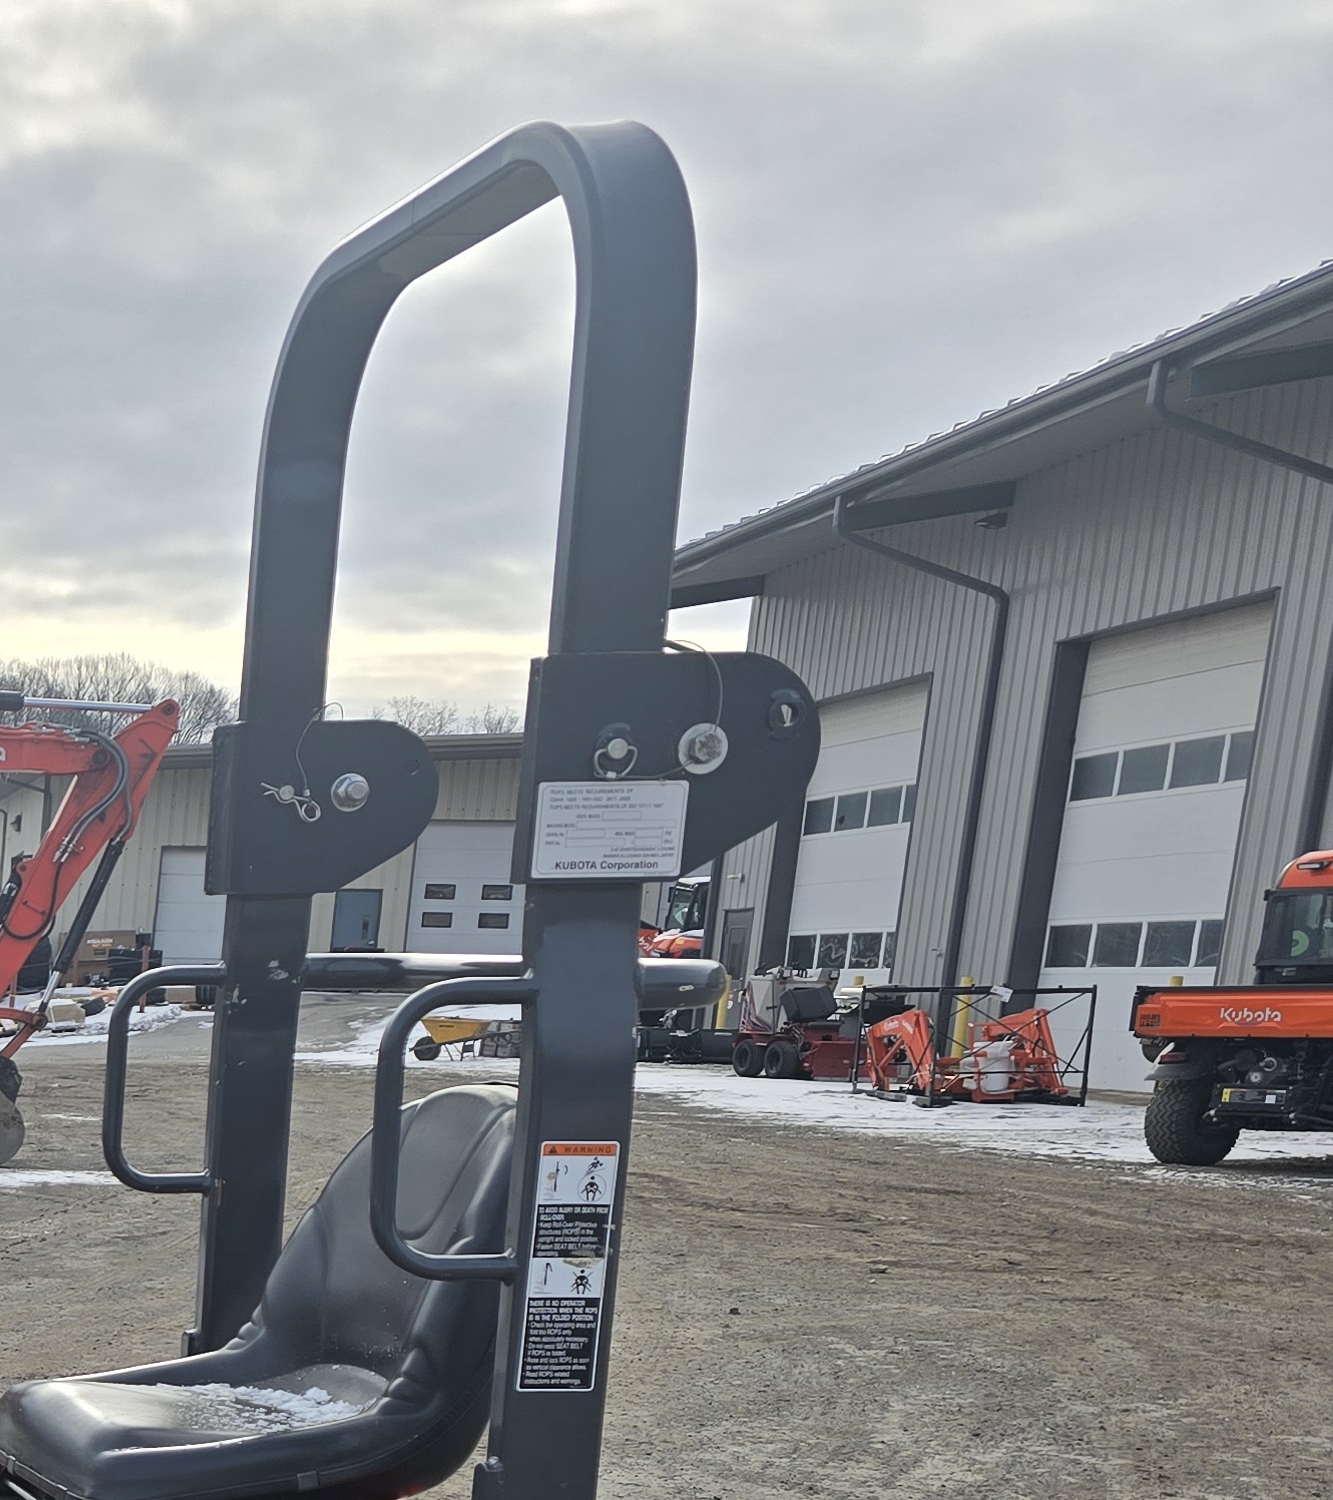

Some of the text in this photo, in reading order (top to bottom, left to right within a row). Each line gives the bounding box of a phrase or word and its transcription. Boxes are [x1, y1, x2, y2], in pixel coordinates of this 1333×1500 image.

[555, 860, 658, 870] KUBOTA Corporation
[1220, 1008, 1282, 1022] Kubota
